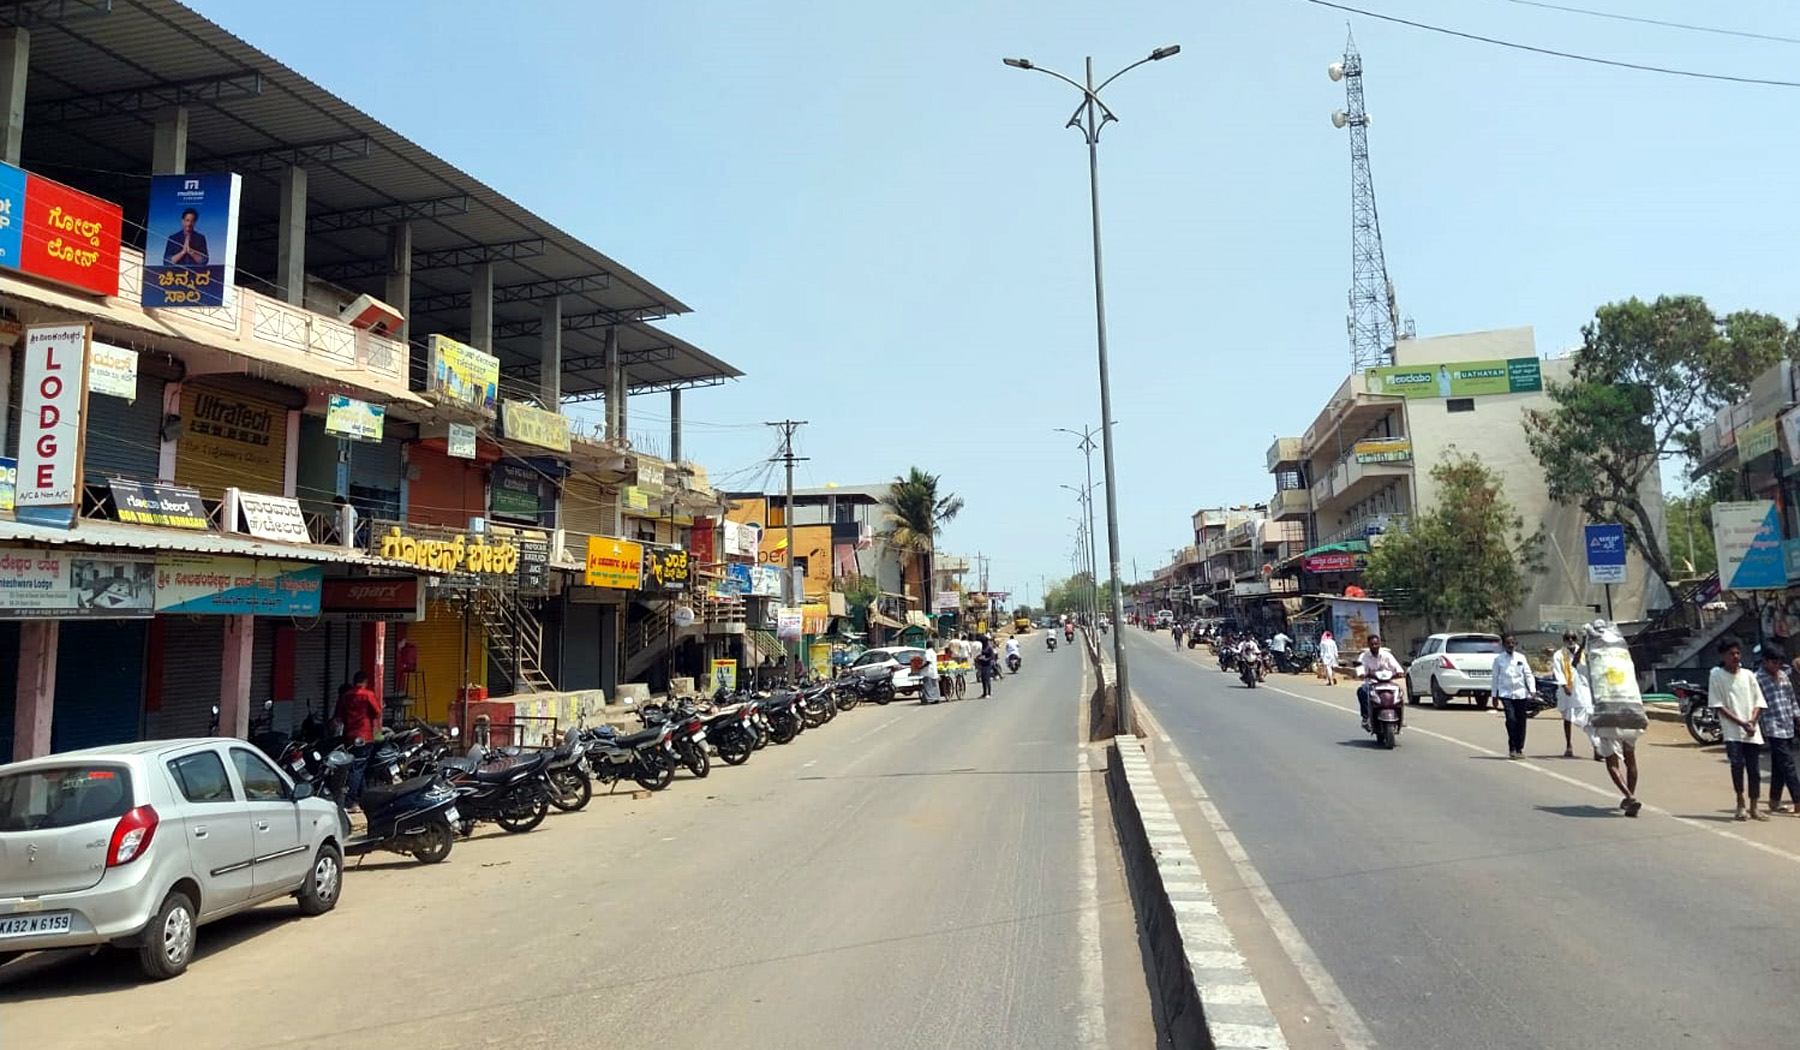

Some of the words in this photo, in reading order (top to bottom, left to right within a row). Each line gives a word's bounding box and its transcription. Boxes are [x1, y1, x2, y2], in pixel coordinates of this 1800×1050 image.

[47, 237, 99, 267] ಲೋನ್
[158, 270, 210, 290] ಚಿನ್ನದ
[164, 288, 201, 303] ಸಾಲ
[37, 347, 62, 488] LODGE
[195, 392, 271, 433] UltraTech
[0, 920, 28, 934] KA32
[30, 918, 38, 931] N
[40, 916, 69, 930] 6159
